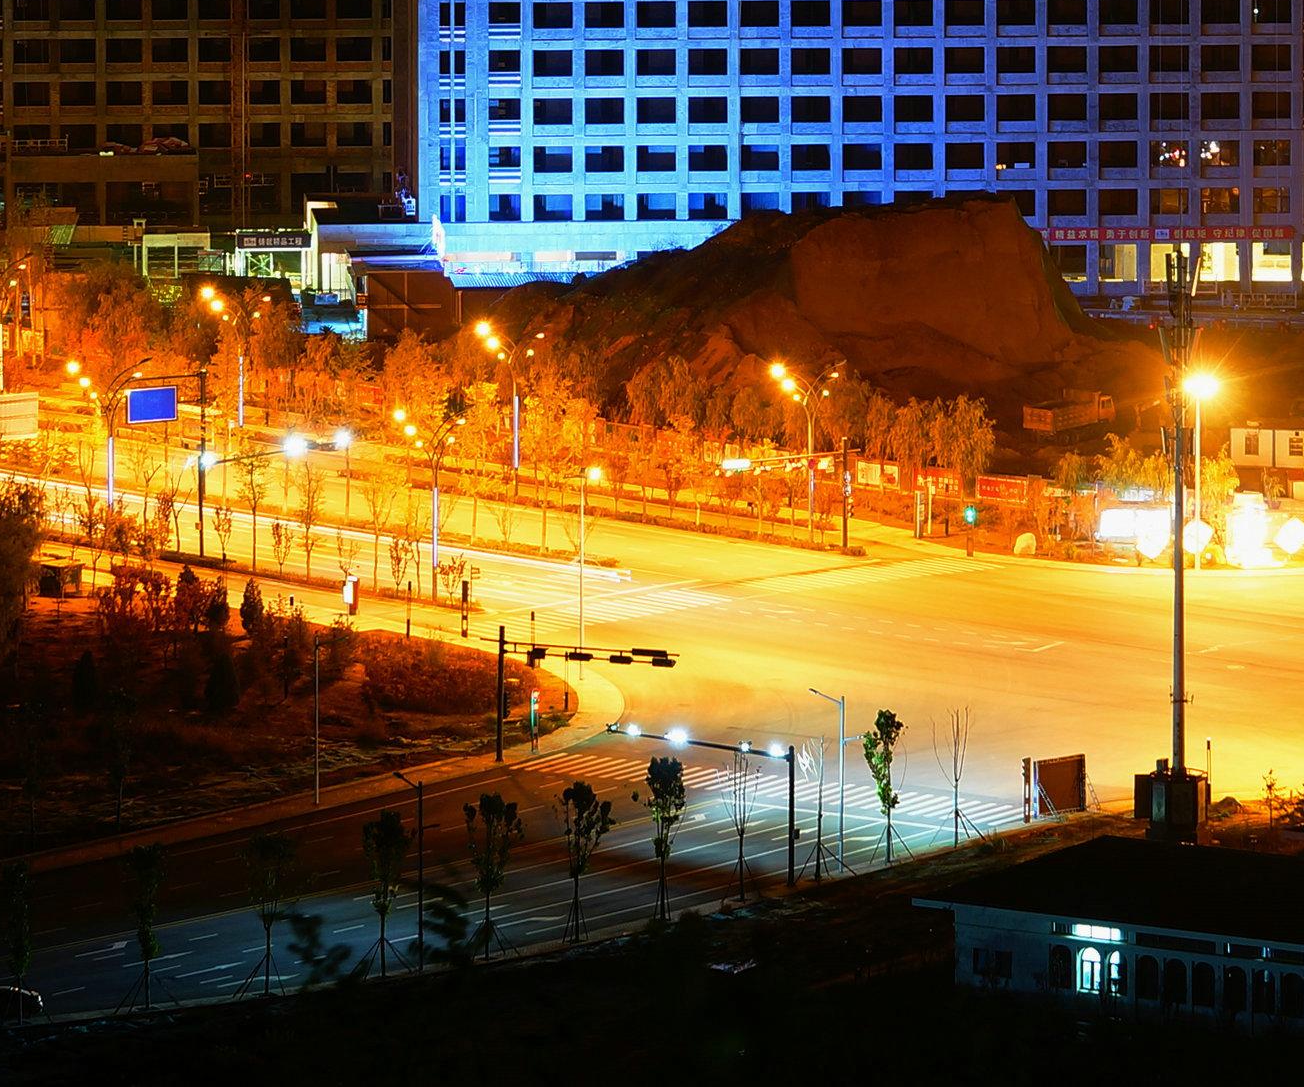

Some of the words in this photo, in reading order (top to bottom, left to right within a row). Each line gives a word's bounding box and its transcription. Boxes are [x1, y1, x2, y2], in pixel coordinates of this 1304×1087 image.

[1055, 229, 1099, 240] 精益求精
[1106, 229, 1150, 240] 勇于创新
